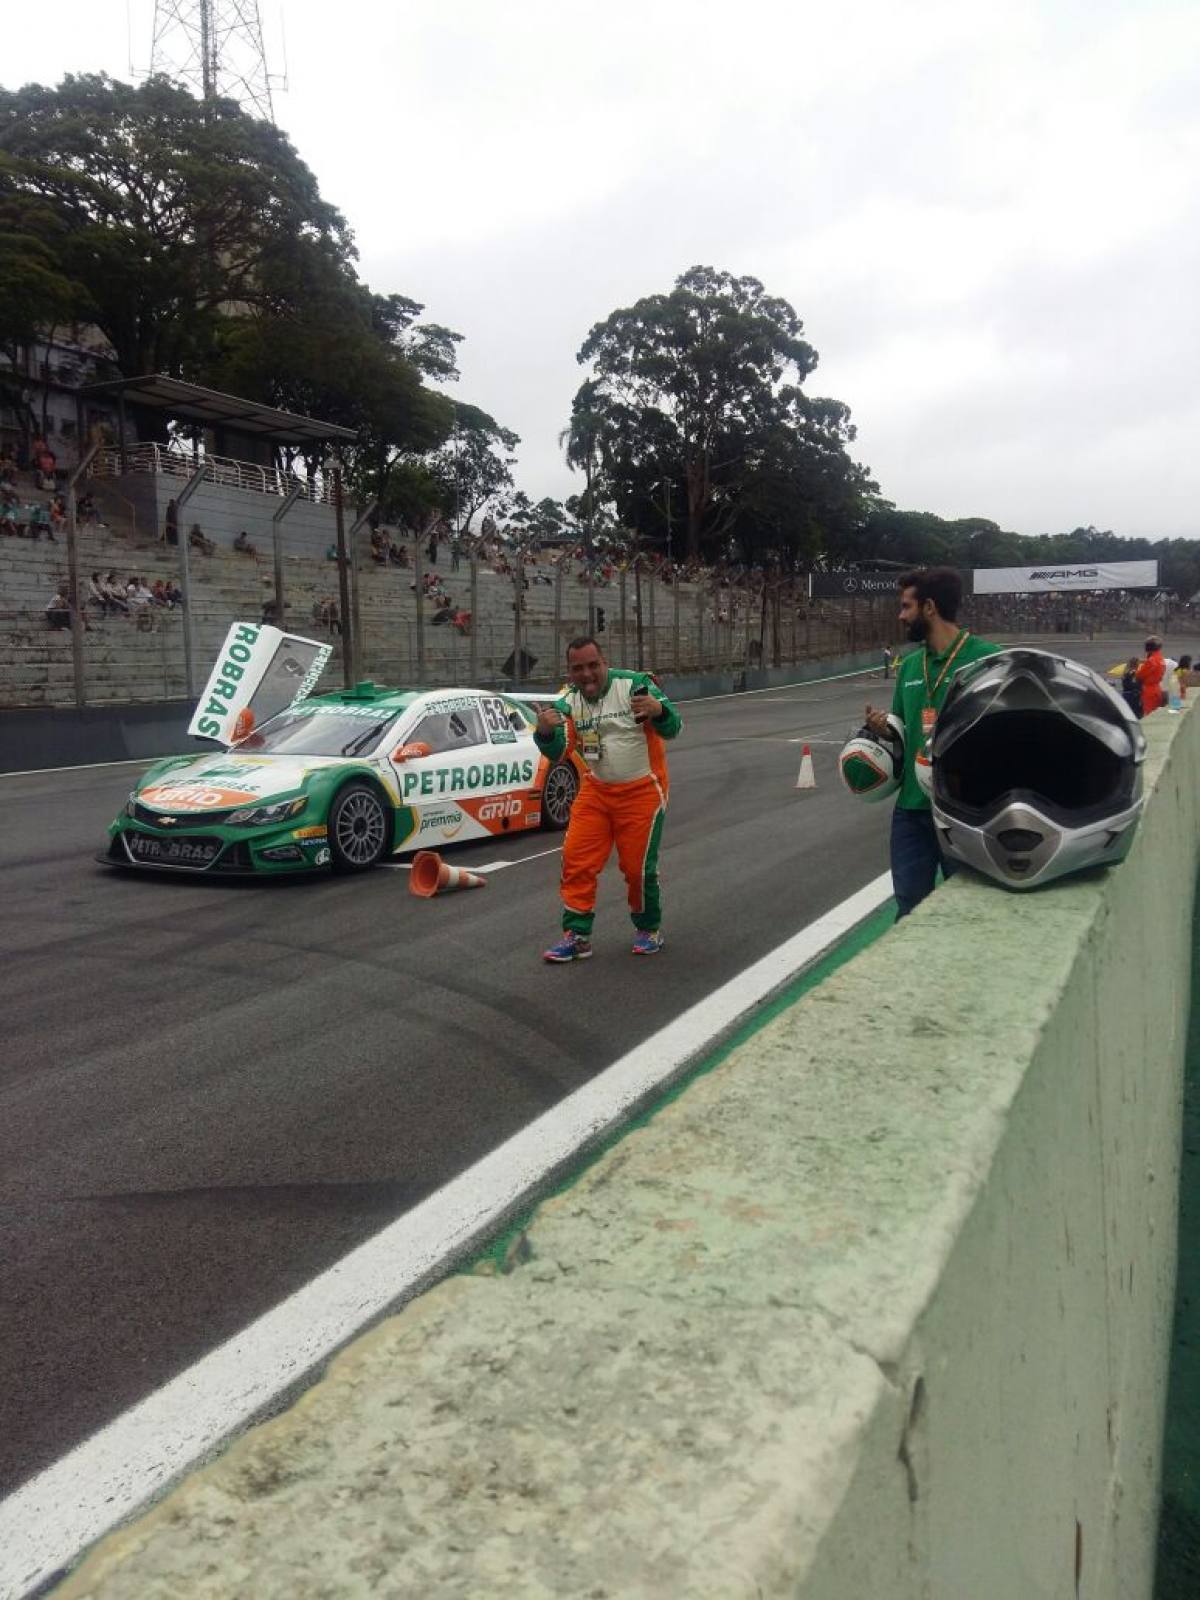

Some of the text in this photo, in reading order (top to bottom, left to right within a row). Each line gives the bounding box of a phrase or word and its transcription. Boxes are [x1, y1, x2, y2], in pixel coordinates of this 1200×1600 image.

[197, 623, 262, 737] ROBRAS
[481, 699, 511, 731] 53
[403, 760, 533, 798] PETROBRAS
